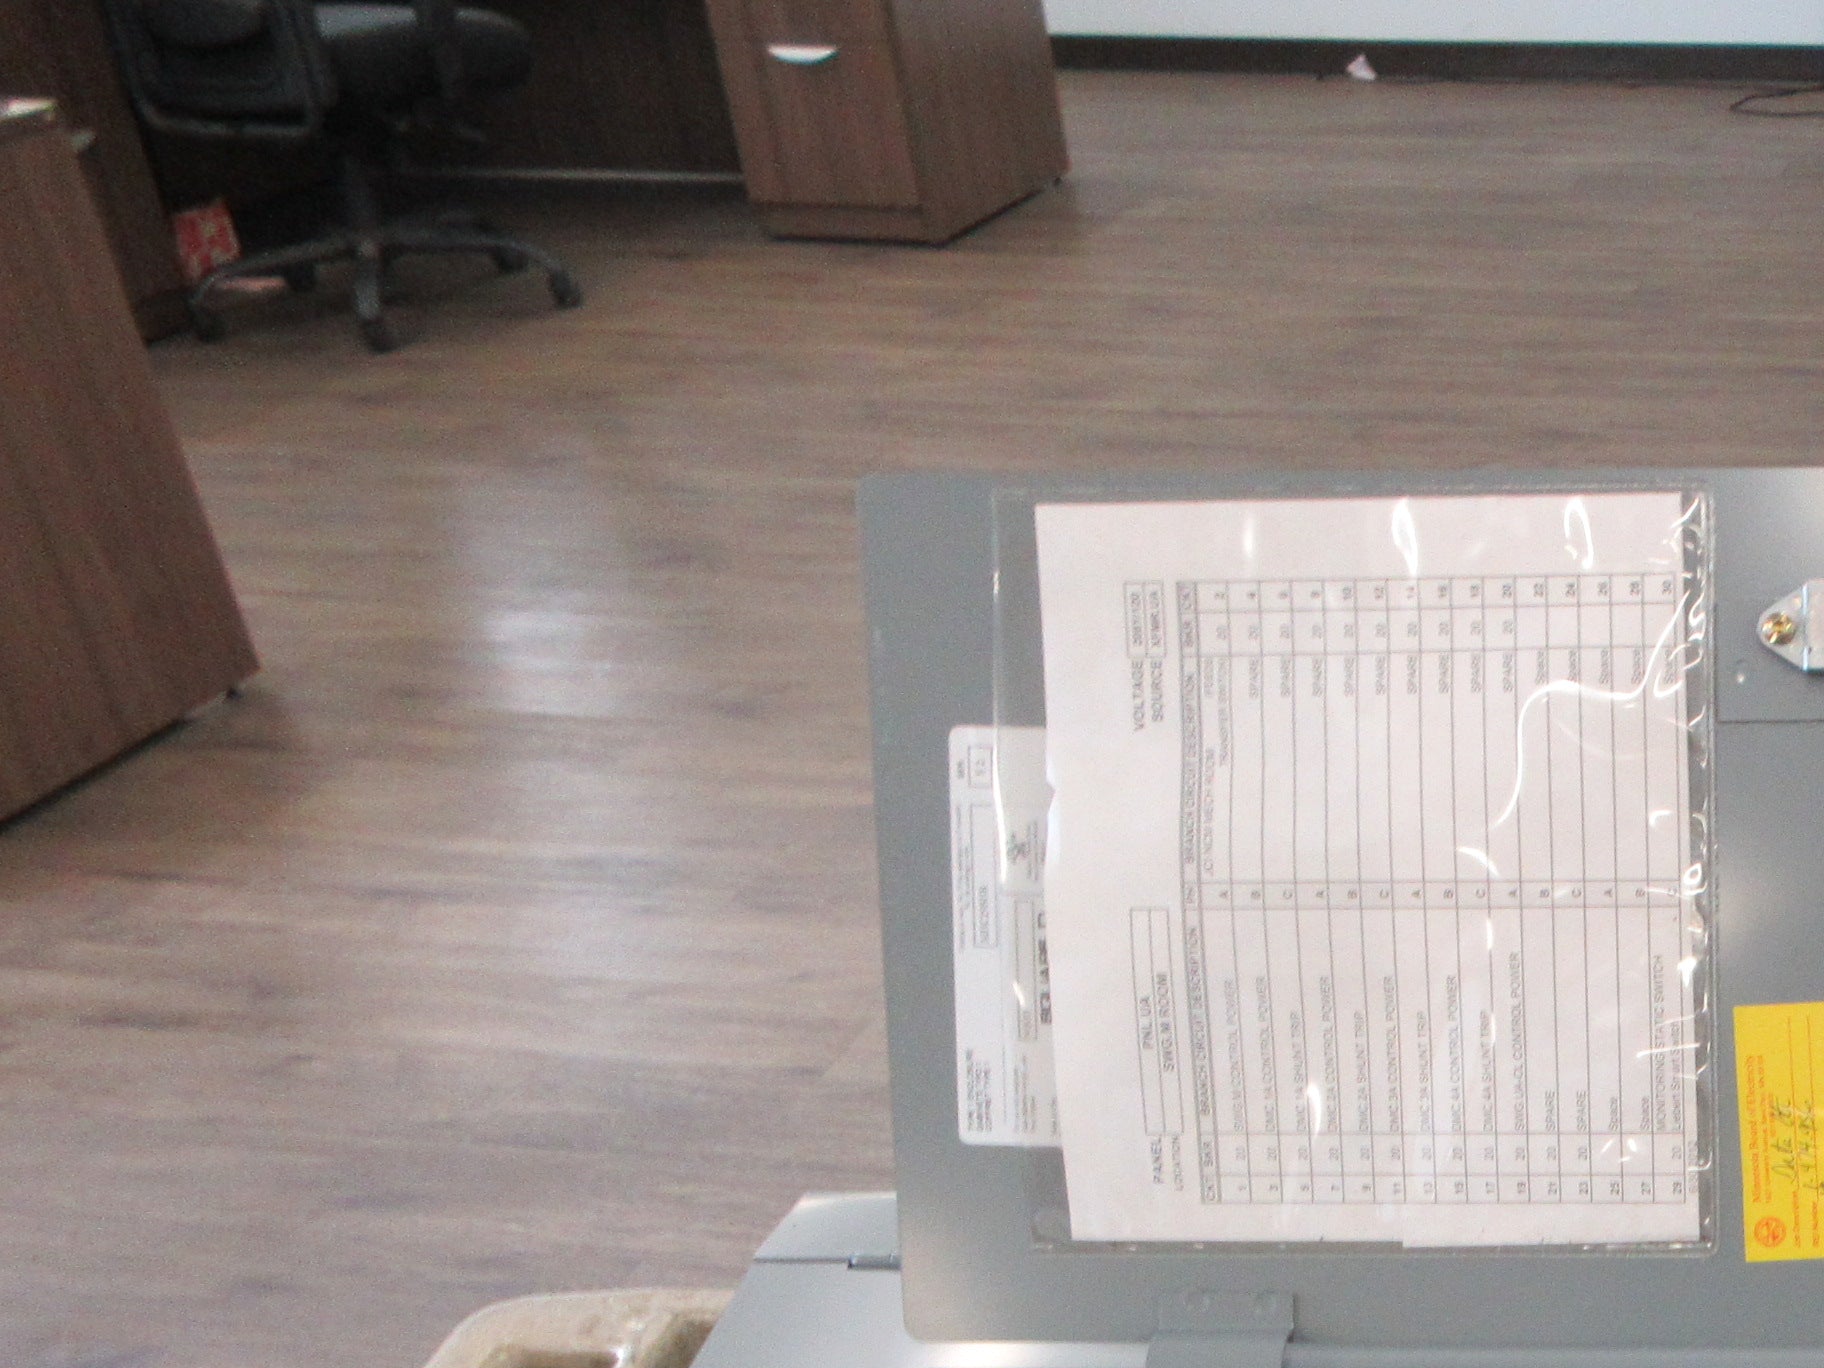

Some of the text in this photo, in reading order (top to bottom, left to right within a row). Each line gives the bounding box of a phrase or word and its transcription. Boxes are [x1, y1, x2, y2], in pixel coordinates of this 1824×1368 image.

[1131, 661, 1144, 731] VOLTAGE
[1150, 661, 1162, 722] SOURCE
[1545, 1090, 1556, 1132] SPARE
[1576, 1091, 1587, 1132] SPARE
